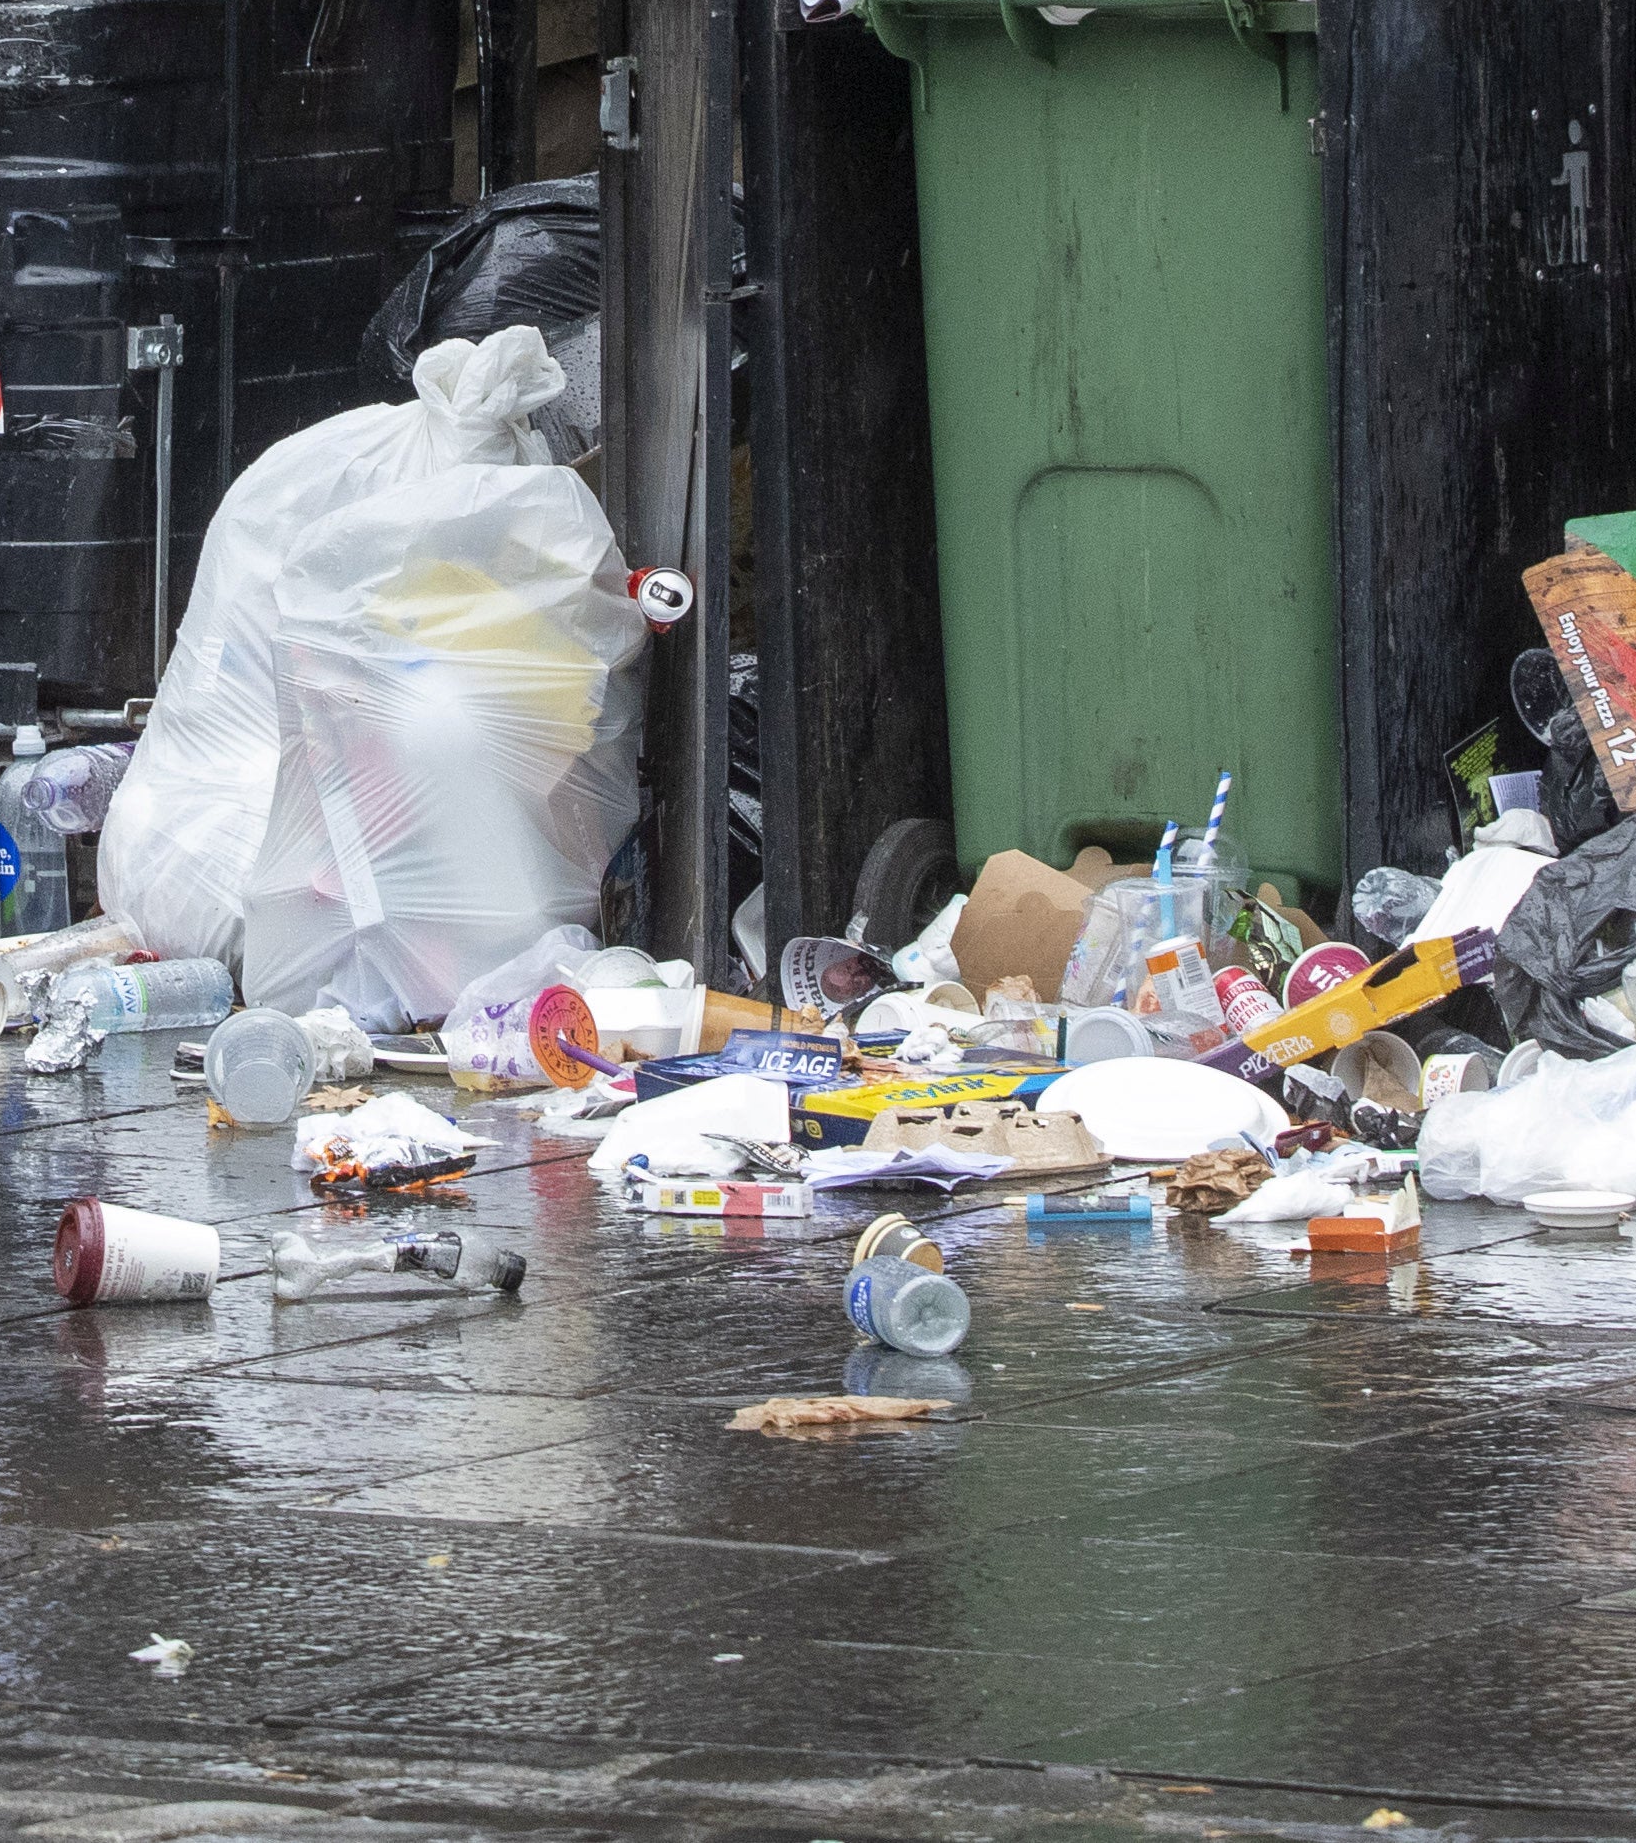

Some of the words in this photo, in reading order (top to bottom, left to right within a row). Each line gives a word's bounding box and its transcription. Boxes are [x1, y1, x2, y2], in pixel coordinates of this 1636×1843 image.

[1558, 611, 1584, 658] Enjoy
[1572, 655, 1597, 689] your
[1591, 686, 1617, 730] Pizza
[1234, 1001, 1270, 1032] BERRY
[759, 1049, 795, 1071] ICE
[797, 1057, 837, 1077] AGE
[1238, 1035, 1316, 1079] PIZZERIA
[884, 1076, 995, 1103] citylink
